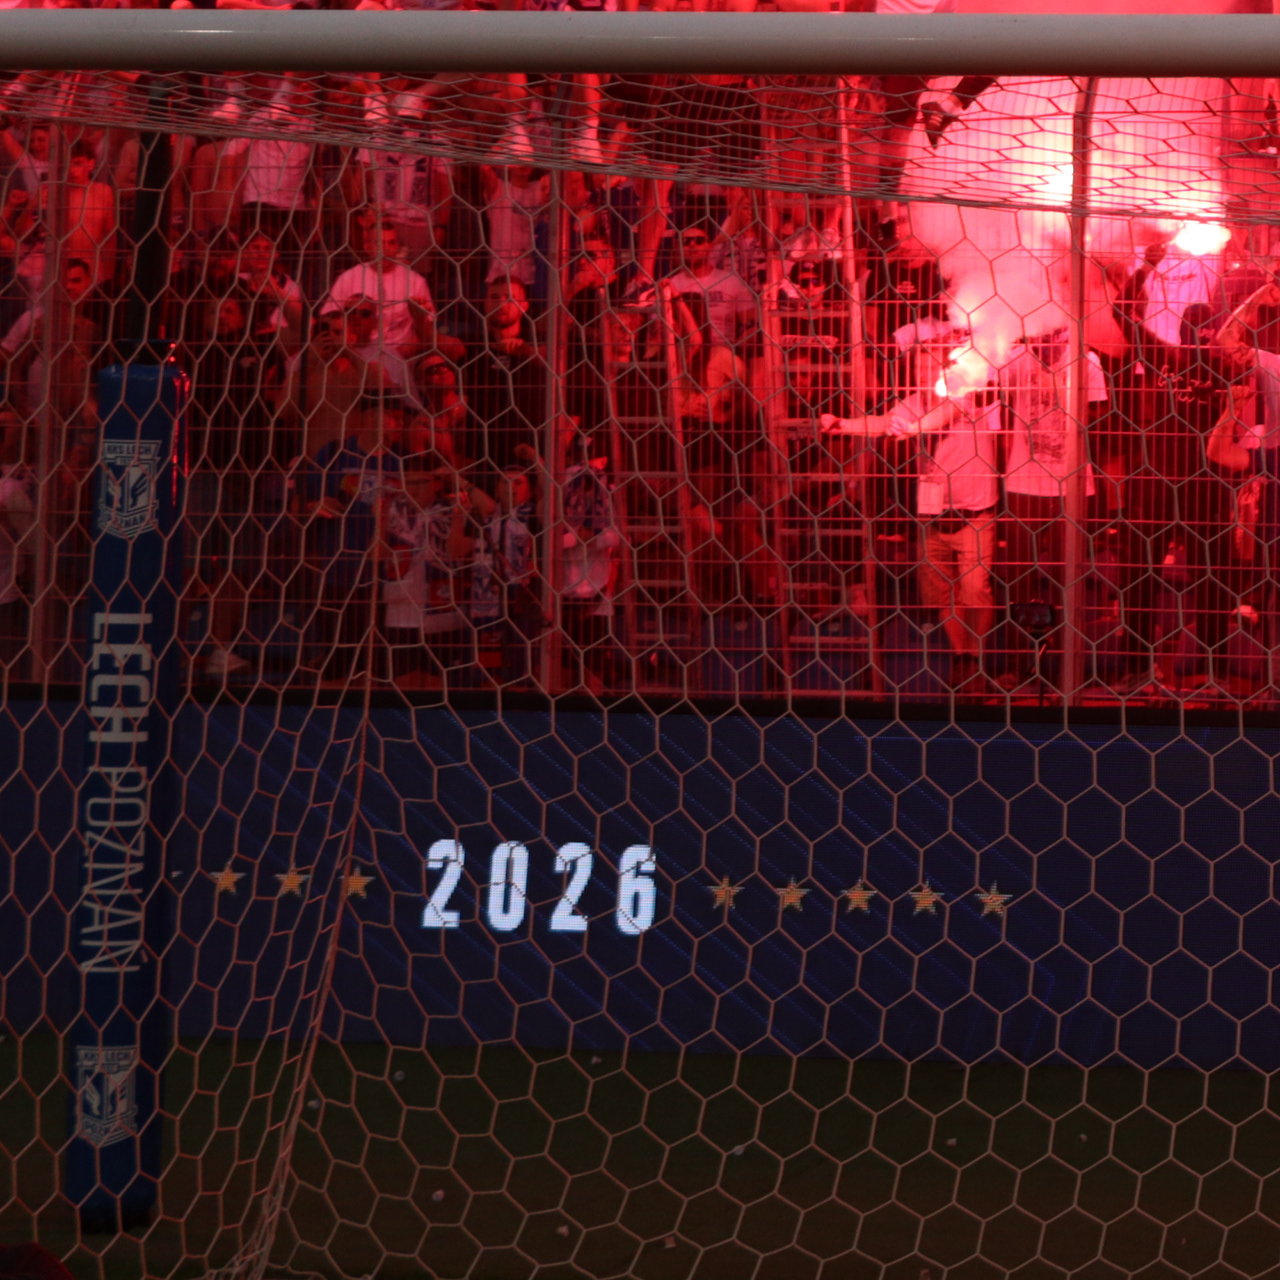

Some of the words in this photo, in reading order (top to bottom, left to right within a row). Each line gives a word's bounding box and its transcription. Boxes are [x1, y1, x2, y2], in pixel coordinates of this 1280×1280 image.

[91, 612, 153, 743] LECH
[79, 765, 150, 973] POZNAŃ
[420, 838, 657, 936] 2026
